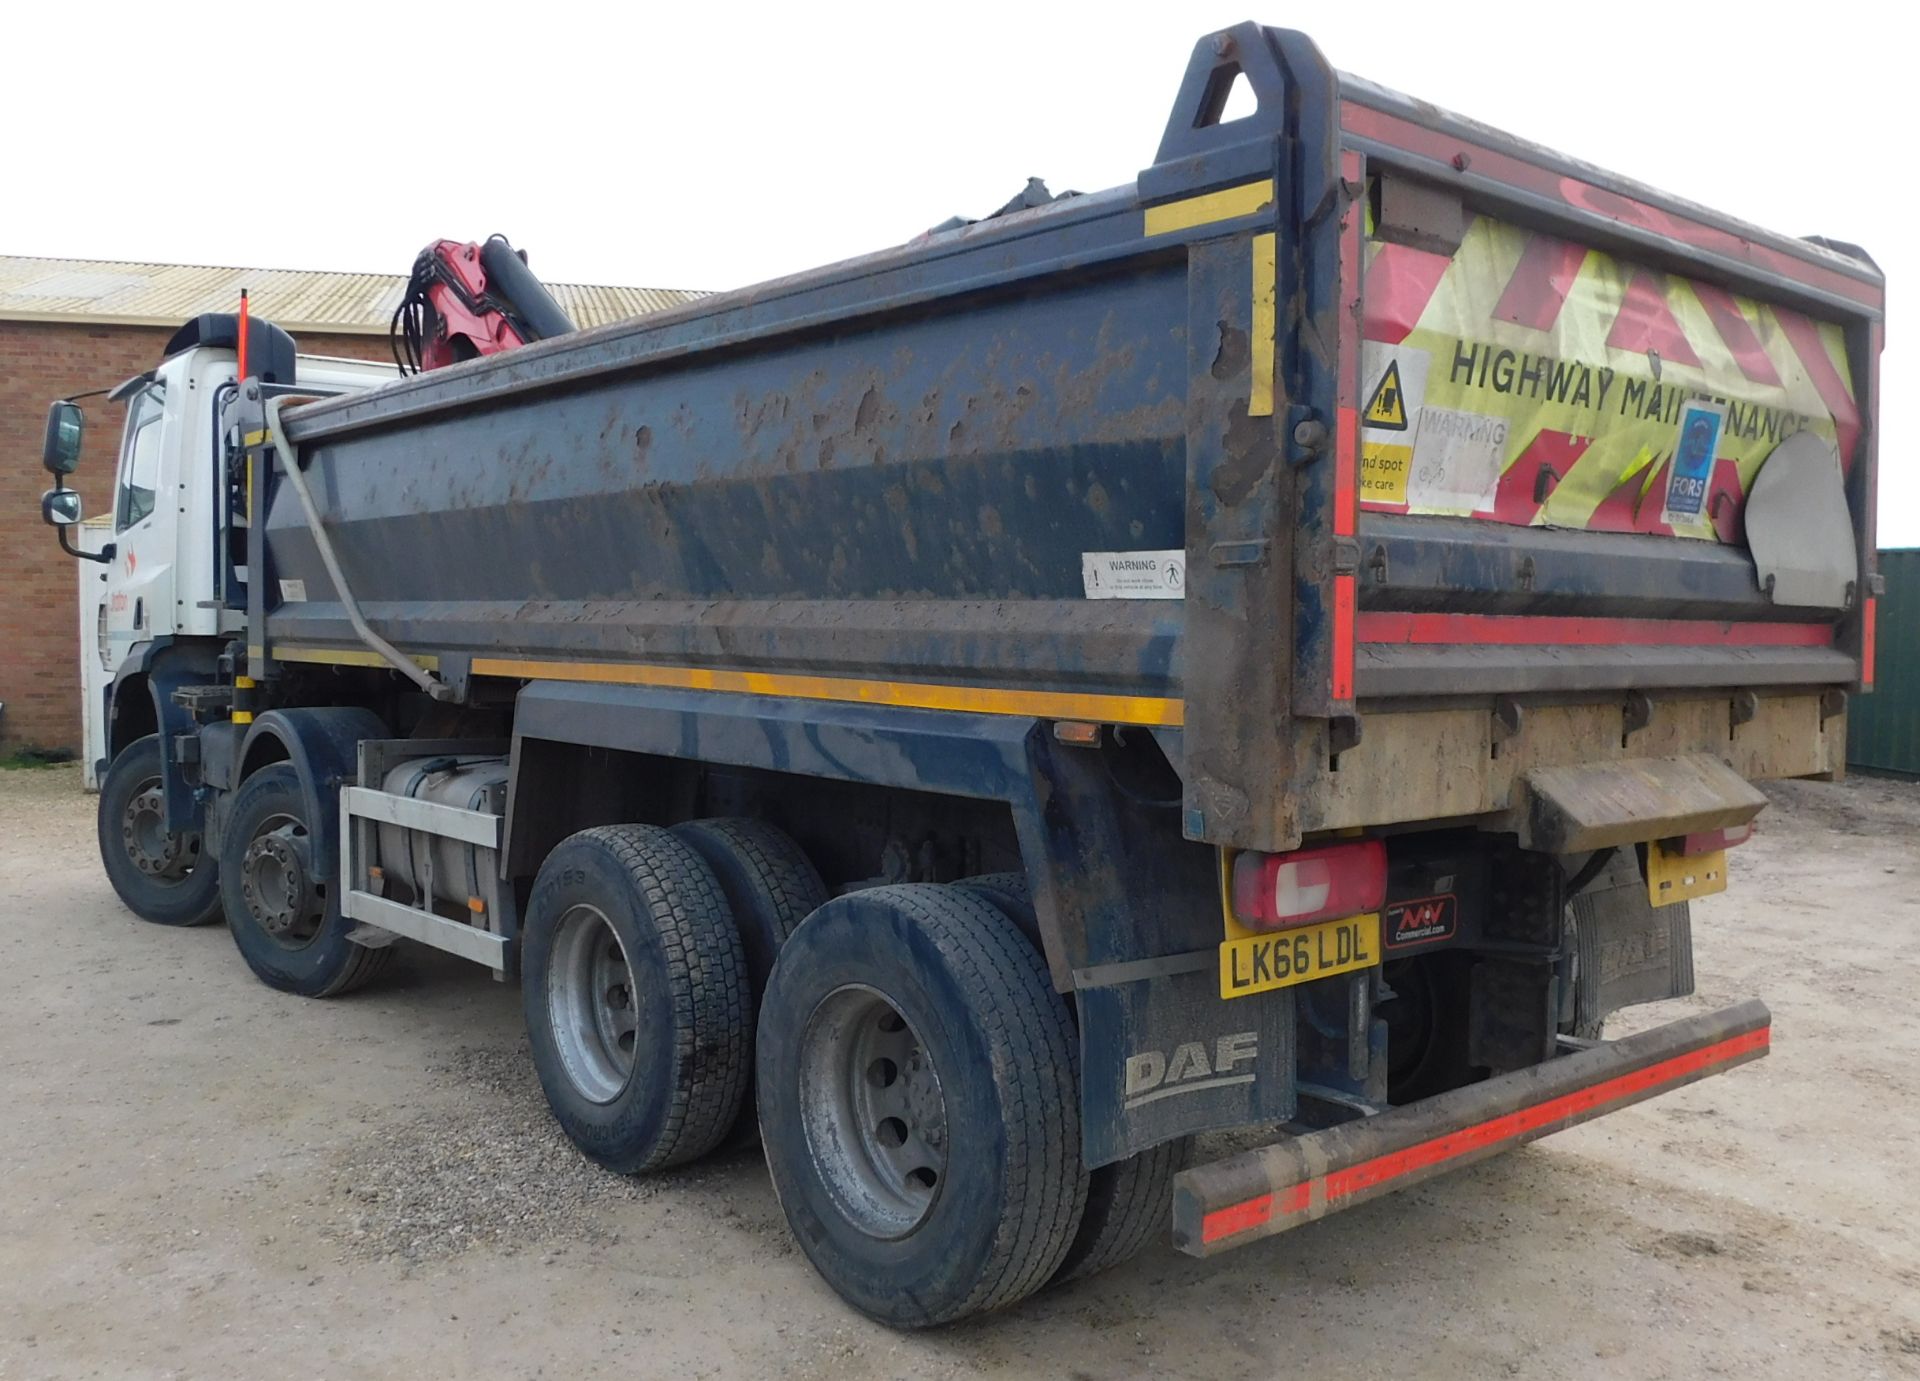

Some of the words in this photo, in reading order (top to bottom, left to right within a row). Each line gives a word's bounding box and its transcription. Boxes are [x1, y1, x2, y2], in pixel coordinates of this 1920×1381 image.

[1450, 340, 1614, 411] HIGHWAY
[1620, 377, 1809, 443] MAINANCE
[1424, 410, 1506, 446] WARNING
[1378, 458, 1404, 474] spot
[1374, 479, 1395, 491] care
[1671, 475, 1704, 498] FORS
[1109, 560, 1157, 572] WARNING
[1395, 925, 1446, 941] Commercial.com
[1231, 935, 1310, 989] LK66
[1318, 924, 1368, 970] LDL
[1125, 1032, 1259, 1097] DAF
